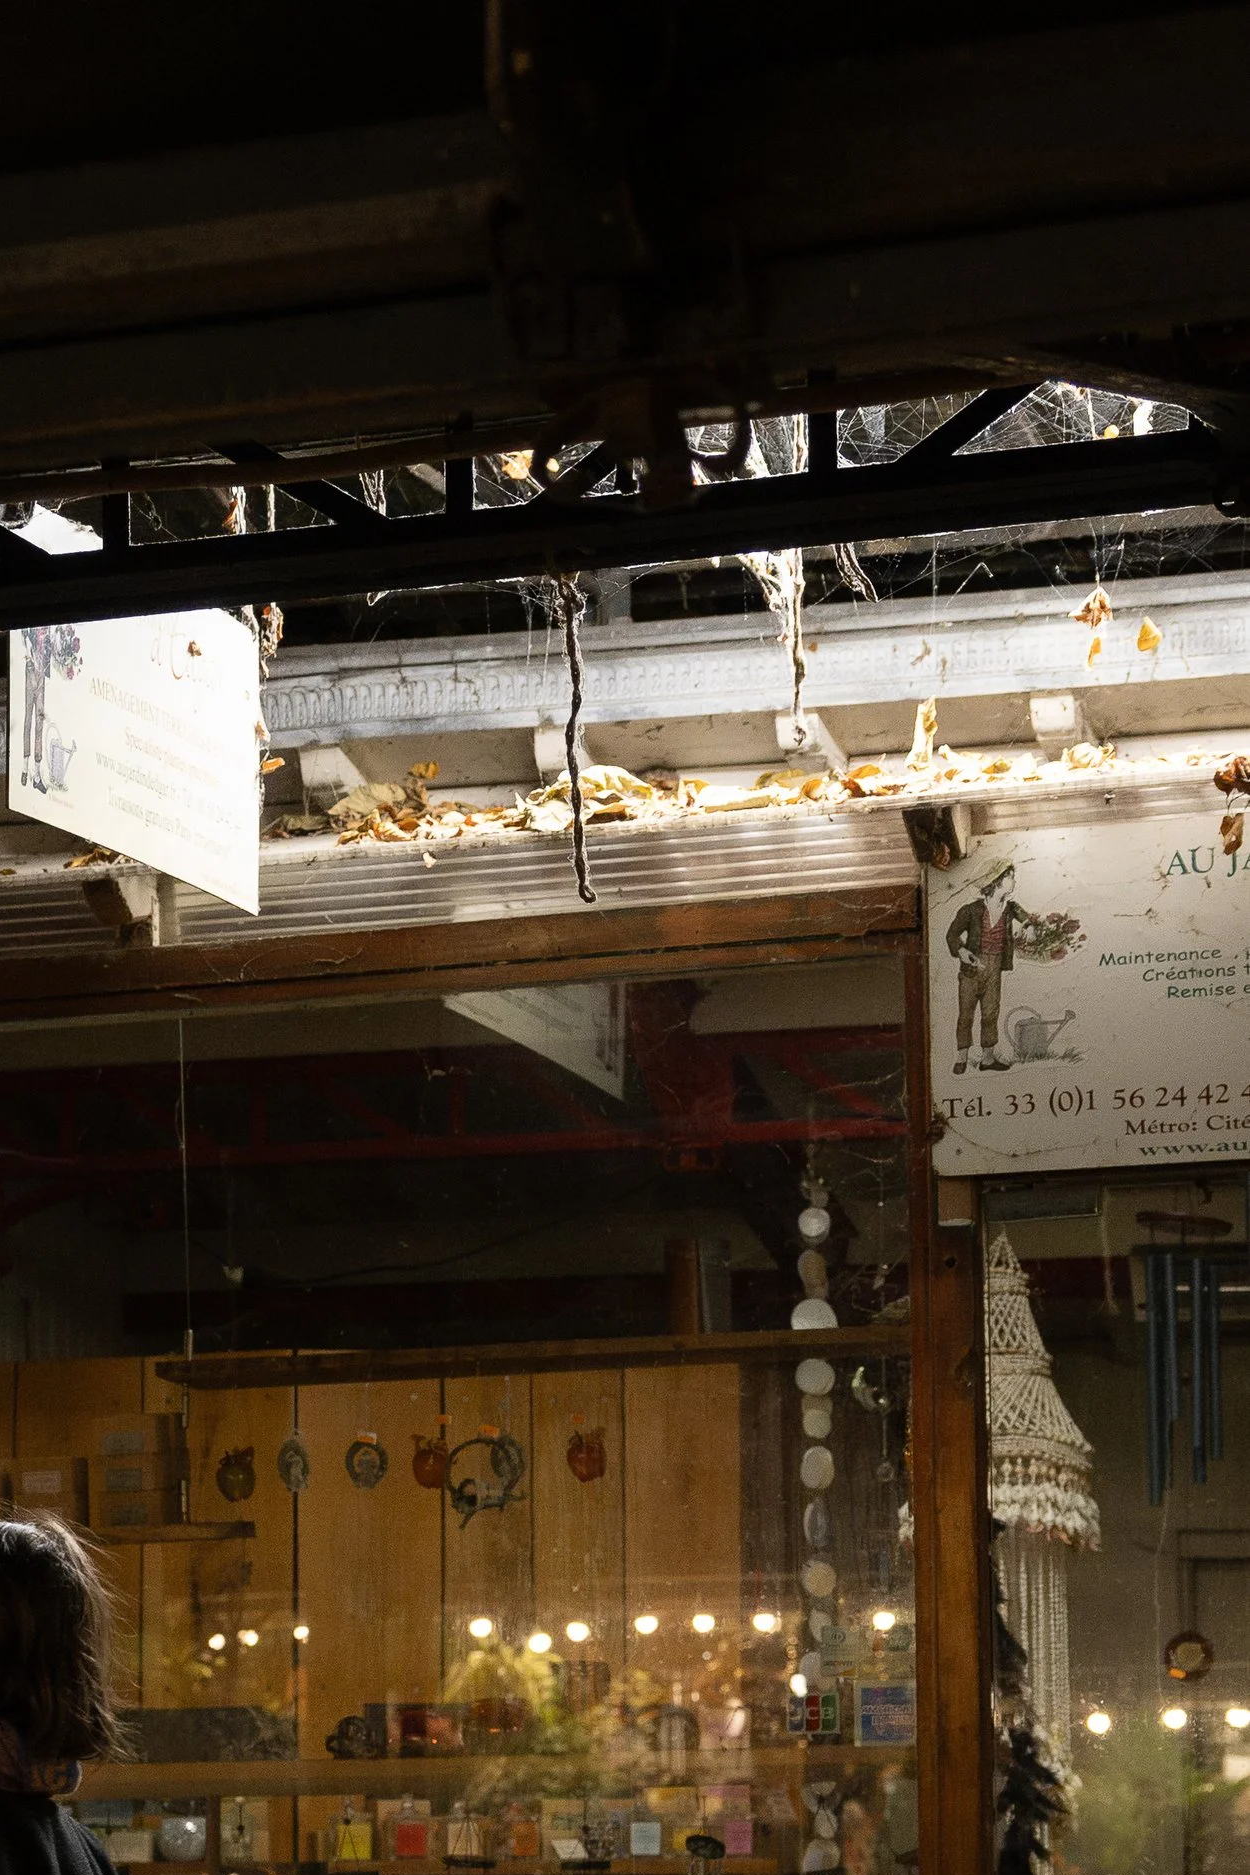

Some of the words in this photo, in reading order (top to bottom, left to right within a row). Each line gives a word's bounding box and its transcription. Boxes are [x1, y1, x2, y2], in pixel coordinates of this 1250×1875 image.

[1166, 846, 1215, 876] AU
[1099, 949, 1223, 967] Maintenance
[1142, 965, 1236, 982] Créations
[1167, 984, 1236, 999] Remise
[942, 1096, 992, 1119] Tél.
[1005, 1093, 1036, 1116] 33
[1050, 1085, 1097, 1117] (0)1
[1112, 1088, 1146, 1110] 56
[1155, 1086, 1188, 1107] 24
[1197, 1083, 1230, 1106] 42
[1125, 1119, 1197, 1136] Métro:
